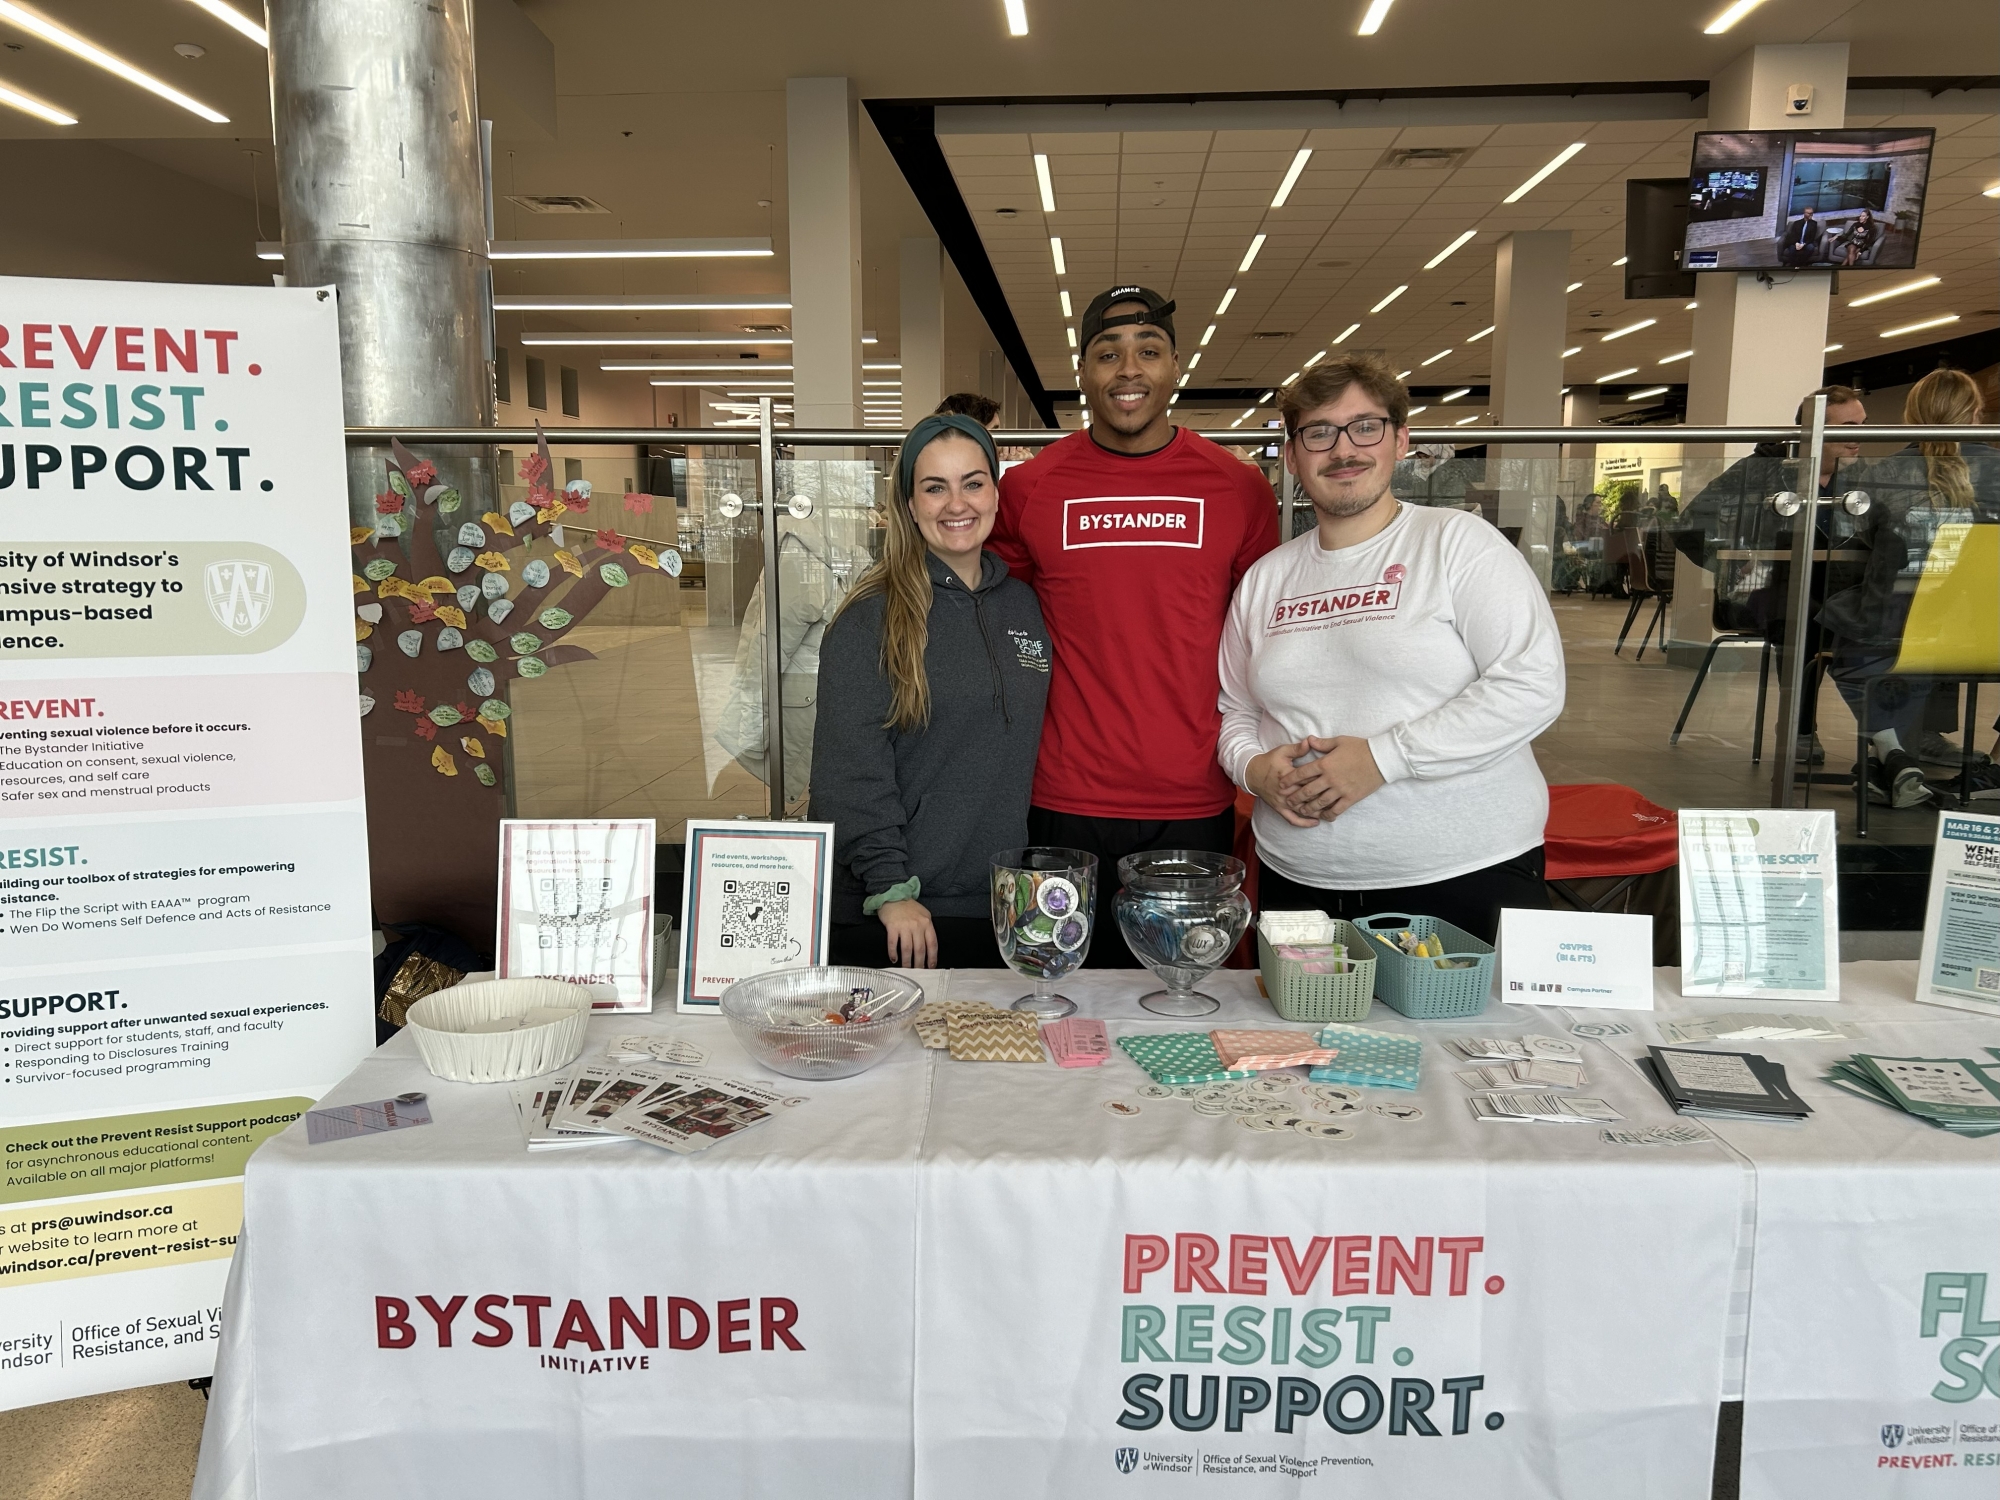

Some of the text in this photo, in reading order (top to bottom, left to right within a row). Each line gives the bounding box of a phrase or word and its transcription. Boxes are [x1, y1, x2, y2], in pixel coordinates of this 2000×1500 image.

[1079, 512, 1187, 531] BYSTANDER
[42, 550, 65, 568] of
[69, 550, 180, 568] Windsor's
[61, 578, 157, 599] strategy
[160, 578, 184, 594] to
[1275, 590, 1391, 622] BYSTANDER
[1330, 620, 1342, 628] End
[1342, 616, 1364, 626] Sexual
[1365, 614, 1396, 622] Violence
[49, 726, 94, 739] sexual
[95, 725, 150, 737] violence
[151, 723, 193, 735] before
[194, 722, 205, 733] it
[205, 723, 252, 733] occurs.
[24, 742, 89, 757] Bystander
[91, 740, 145, 752] Initiative
[66, 759, 83, 768] on
[85, 755, 139, 767] consent,
[141, 753, 181, 765] sexual
[182, 752, 236, 763] violence,
[1948, 822, 1970, 830] MAR
[1972, 824, 1982, 832] 16
[1983, 826, 1992, 834] &
[1758, 854, 1776, 864] THE
[1779, 854, 1819, 864] SCRIPT
[42, 877, 65, 887] our
[66, 873, 116, 885] toolbox
[117, 870, 131, 882] of
[132, 867, 197, 881] strategies
[198, 866, 217, 876] for
[218, 861, 296, 877] empowering
[8, 909, 33, 919] The
[35, 906, 57, 920] Flip
[59, 905, 81, 916] the
[83, 902, 120, 916] Script
[121, 900, 148, 911] with
[197, 894, 251, 909] program
[9, 903, 332, 935] Wen Do Womens Self Defence and Acts of Resistance
[1192, 938, 1208, 950] LUX
[1569, 954, 1576, 962] &
[1578, 954, 1596, 964] FTS)
[1566, 986, 1590, 994] Campus
[0, 1001, 330, 1040] roviding support after unwanted sexual experiences.
[14, 1019, 284, 1054] Direct support for students, staff, and faculty
[15, 1056, 211, 1085] Survivor-focused programming
[5, 1139, 49, 1154] Check
[50, 1137, 74, 1149] out
[75, 1135, 99, 1146] the
[100, 1128, 153, 1144] Prevent
[154, 1123, 194, 1138] Resist
[195, 1117, 248, 1134] Support
[641, 1120, 690, 1140] BYSTANDER
[10, 1221, 27, 1234] at
[31, 1204, 173, 1236] prs@uwindsor.ca
[0, 1234, 237, 1275] windsor.ca/prevent-resist-su
[1122, 1232, 1506, 1297] PREVENT.
[71, 1324, 121, 1343] Office
[125, 1318, 142, 1335] of
[146, 1309, 203, 1332] Sexual
[374, 1294, 807, 1354] BYSTANDER
[72, 1336, 169, 1360] Resistance,
[173, 1326, 204, 1345] and
[1120, 1304, 1414, 1369] RESIST.
[540, 1354, 650, 1375] INITIATIVE
[1115, 1373, 1506, 1437] SUPPORT.
[1906, 1425, 1952, 1437] University
[1913, 1435, 1951, 1445] Windsor
[1142, 1452, 1194, 1465] University
[1150, 1462, 1193, 1472] Windsor
[1203, 1454, 1374, 1468] Office of Sexual Violence Prevention,
[1877, 1454, 1958, 1469] PREVENT.
[1202, 1464, 1318, 1479] Resistance, and Support
